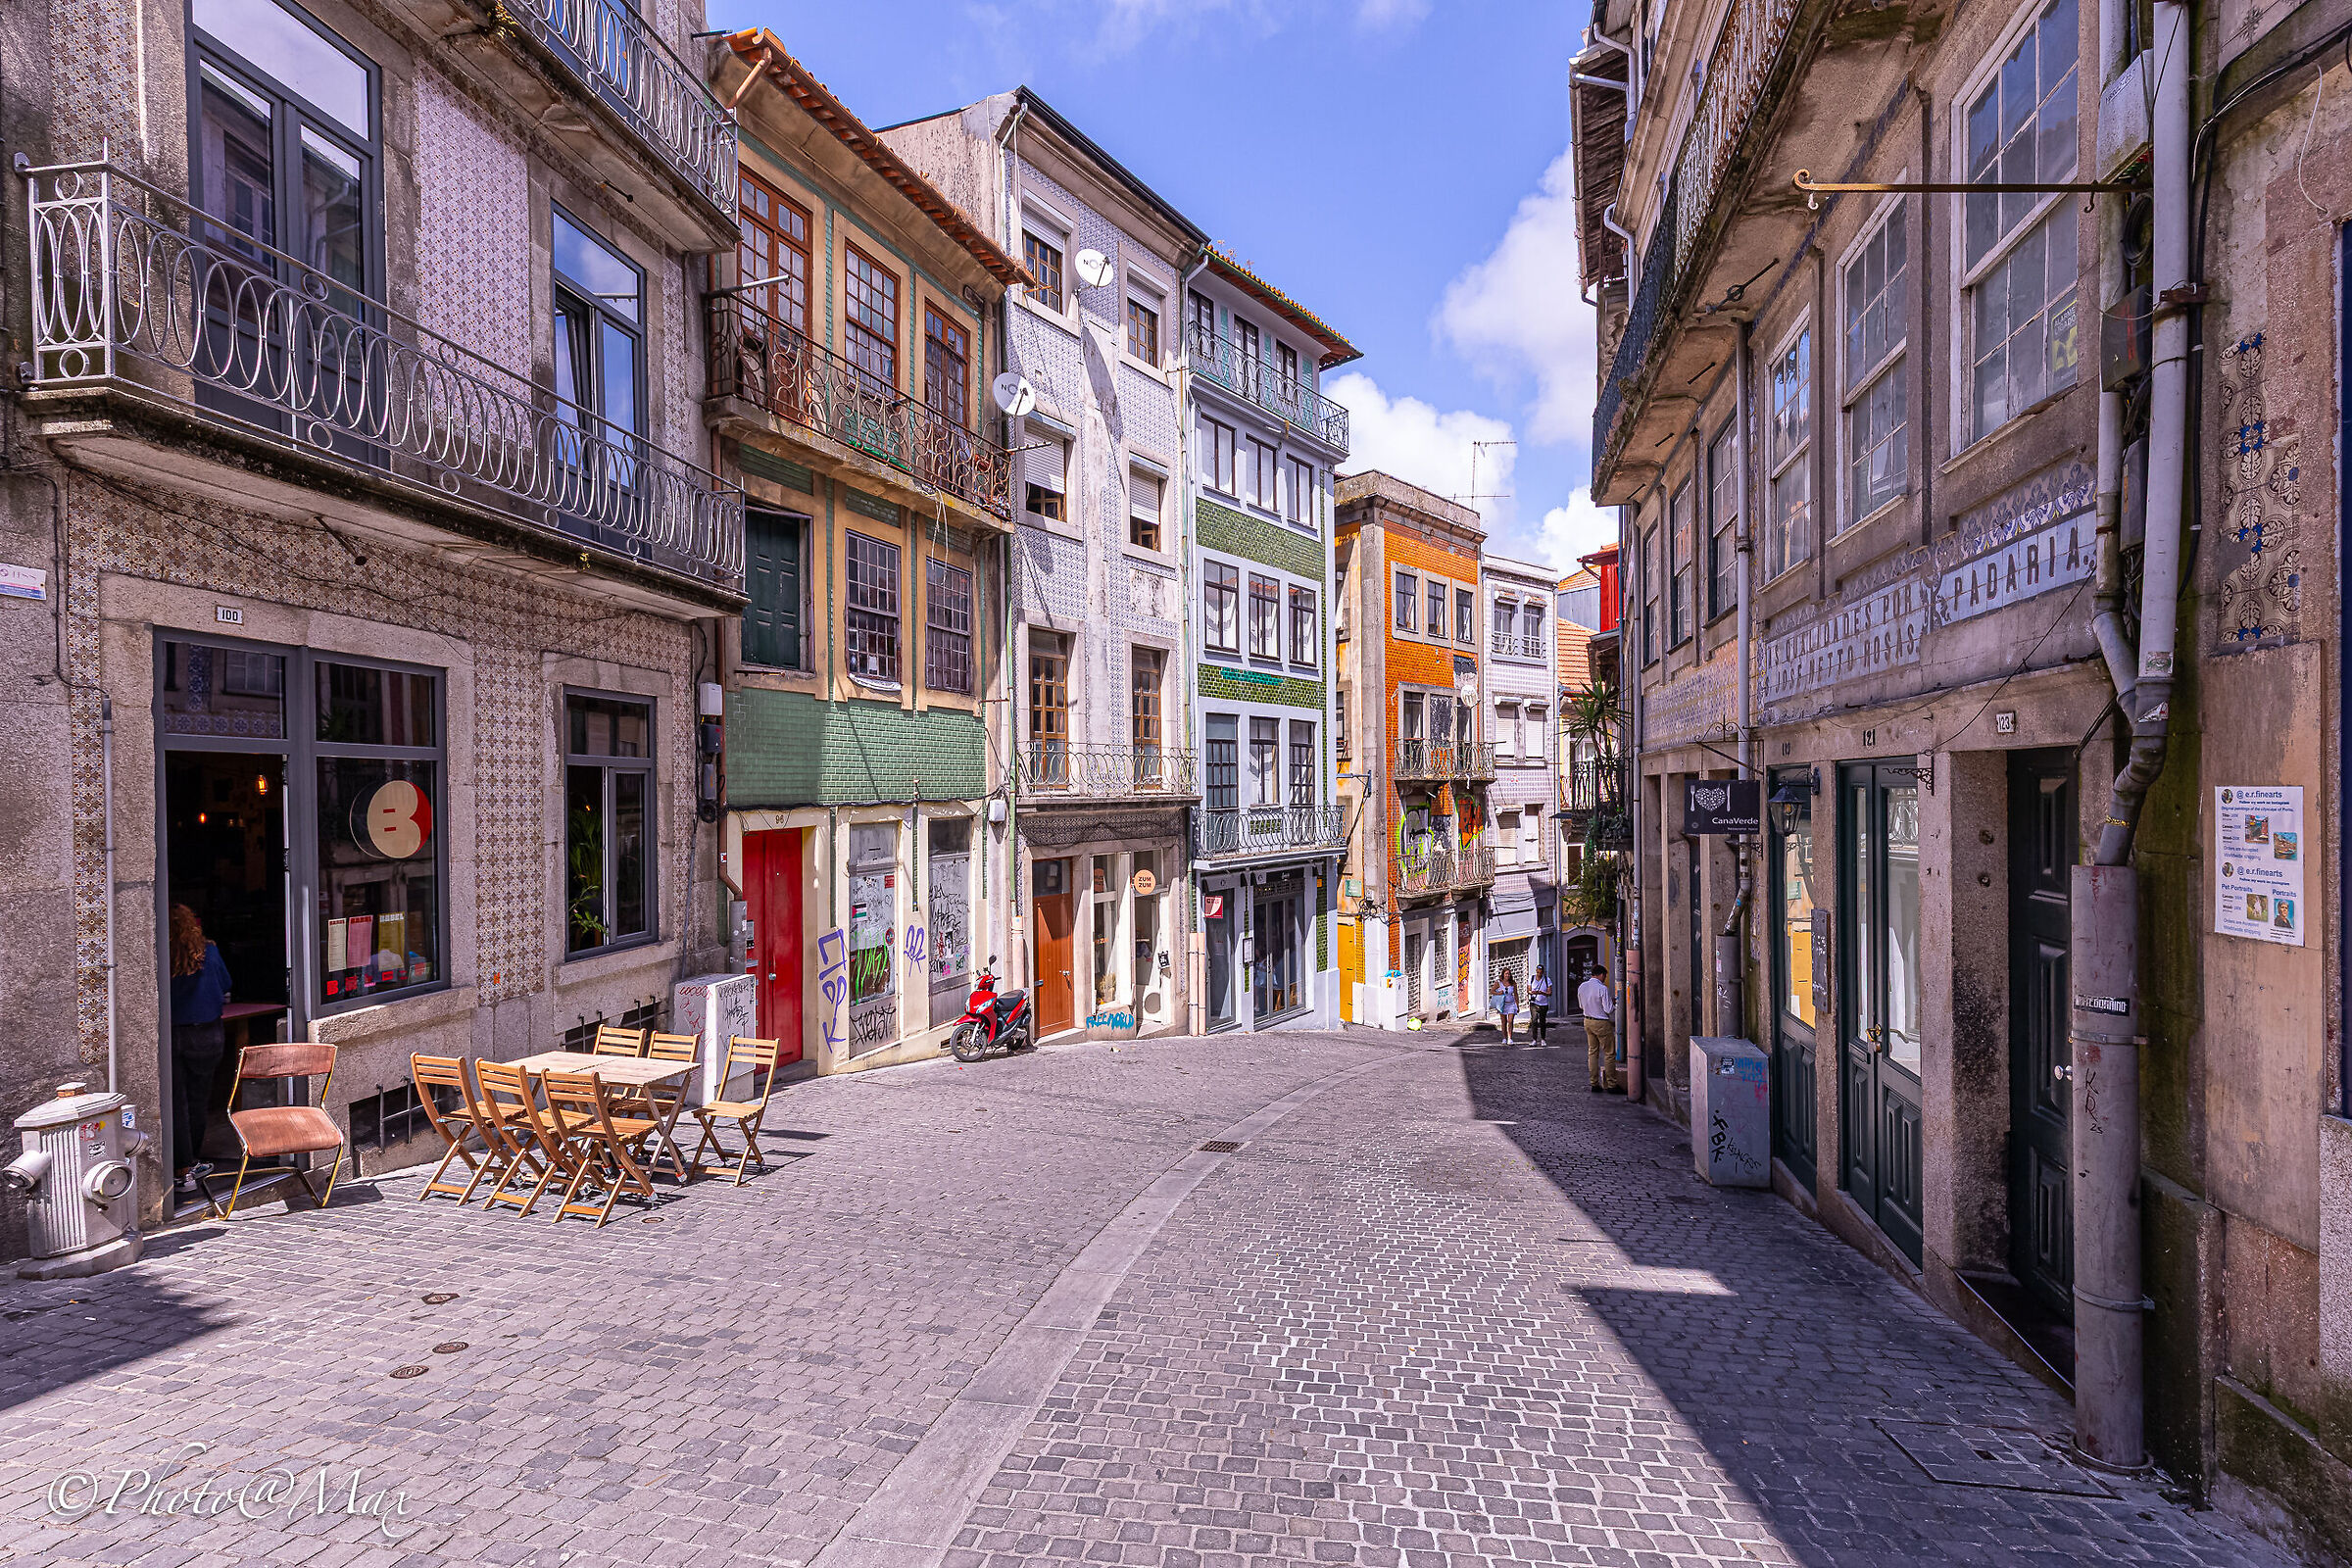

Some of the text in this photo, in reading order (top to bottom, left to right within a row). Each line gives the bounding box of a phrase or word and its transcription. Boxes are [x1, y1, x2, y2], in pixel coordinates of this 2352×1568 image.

[221, 609, 238, 622] 100
[1786, 602, 1873, 662] QUALIDADES
[1883, 585, 1912, 624] POR
[1809, 645, 1854, 685] NETTO
[1999, 716, 2011, 730] 123
[1863, 728, 1876, 746] 121
[775, 814, 785, 824] 96
[1711, 816, 1759, 825] CanaVerde
[2230, 884, 2253, 893] Portraits
[2272, 888, 2297, 898] Portraits
